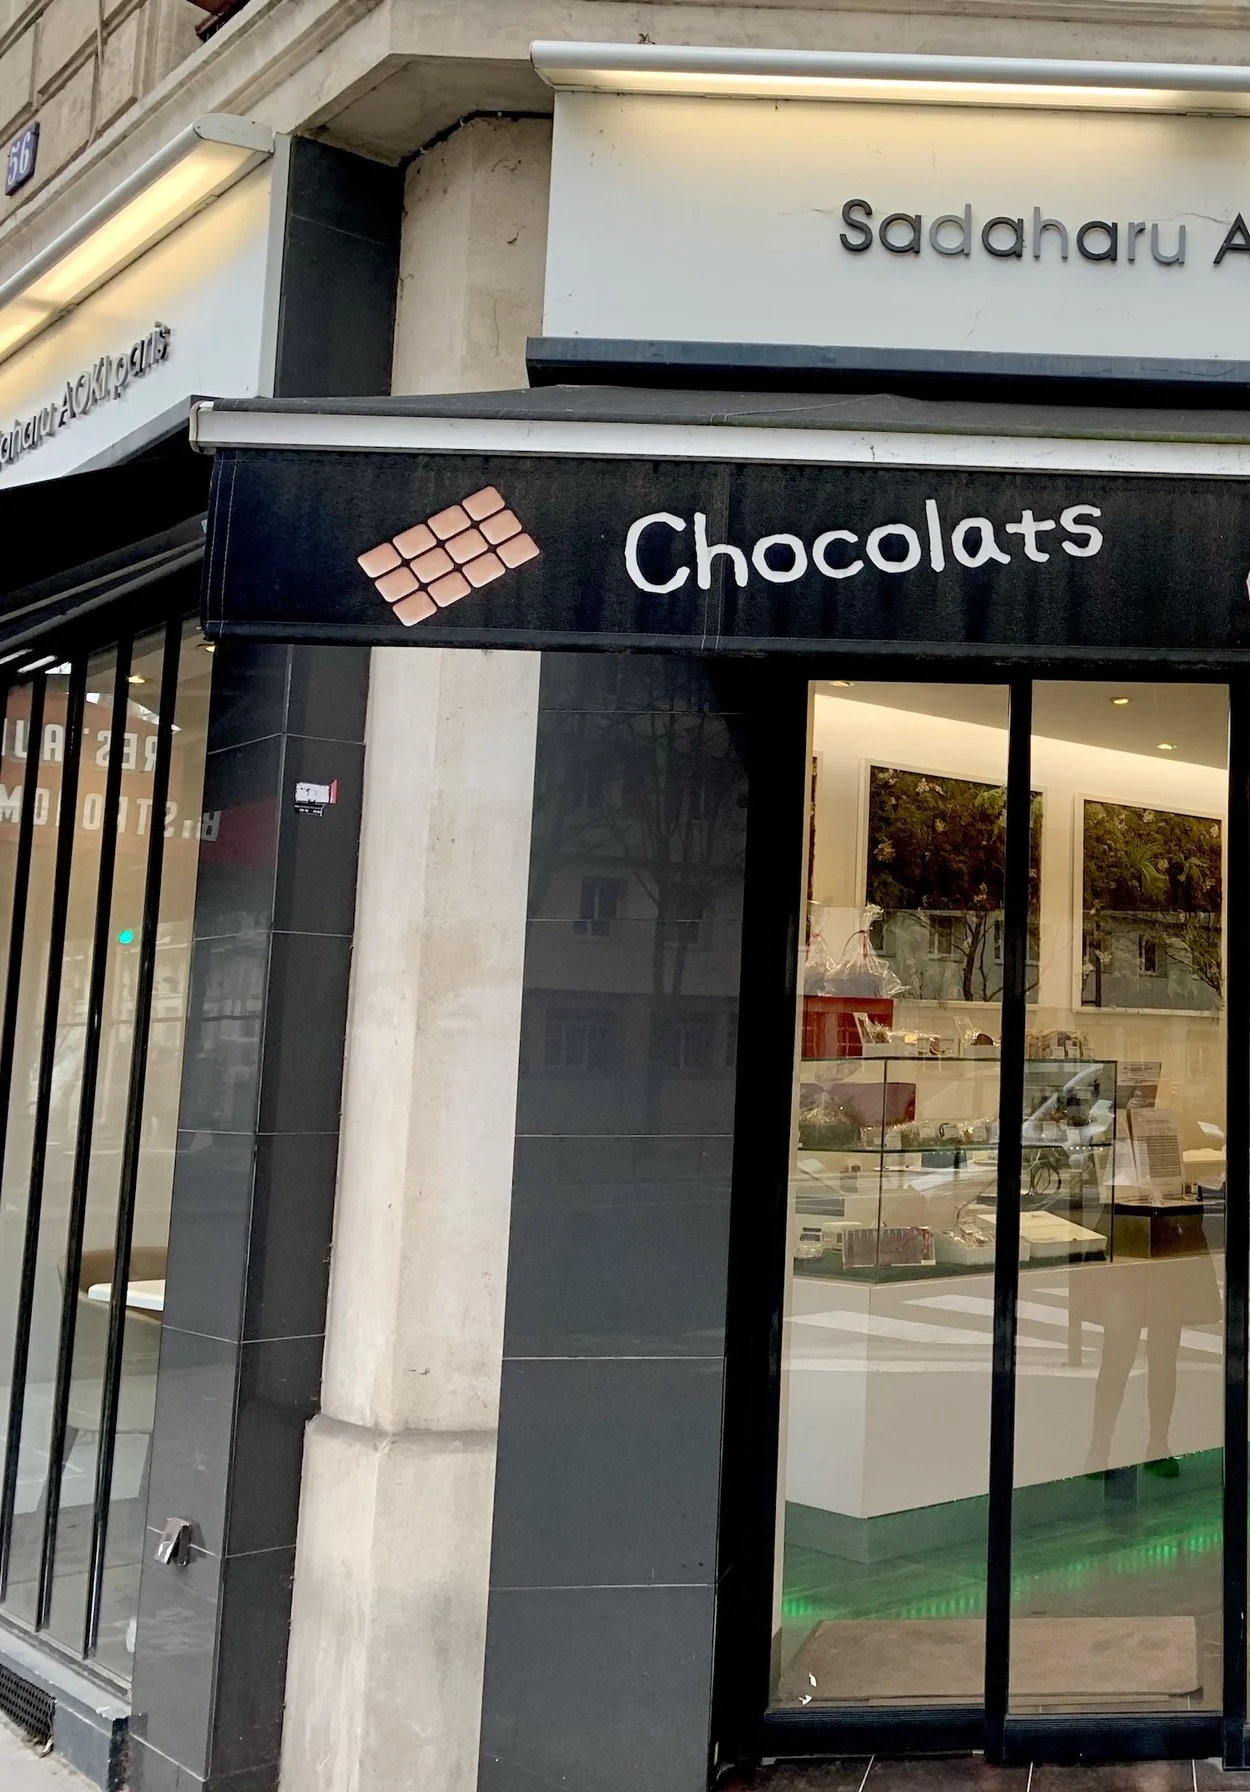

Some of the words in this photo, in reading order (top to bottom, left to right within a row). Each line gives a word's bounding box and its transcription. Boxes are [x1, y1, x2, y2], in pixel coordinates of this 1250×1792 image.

[7, 131, 32, 186] 56
[839, 198, 1187, 266] Sadaharu
[0, 403, 57, 464] aharu
[58, 355, 112, 427] AOKI
[111, 321, 171, 399] paris
[624, 498, 1104, 595] Chocolats
